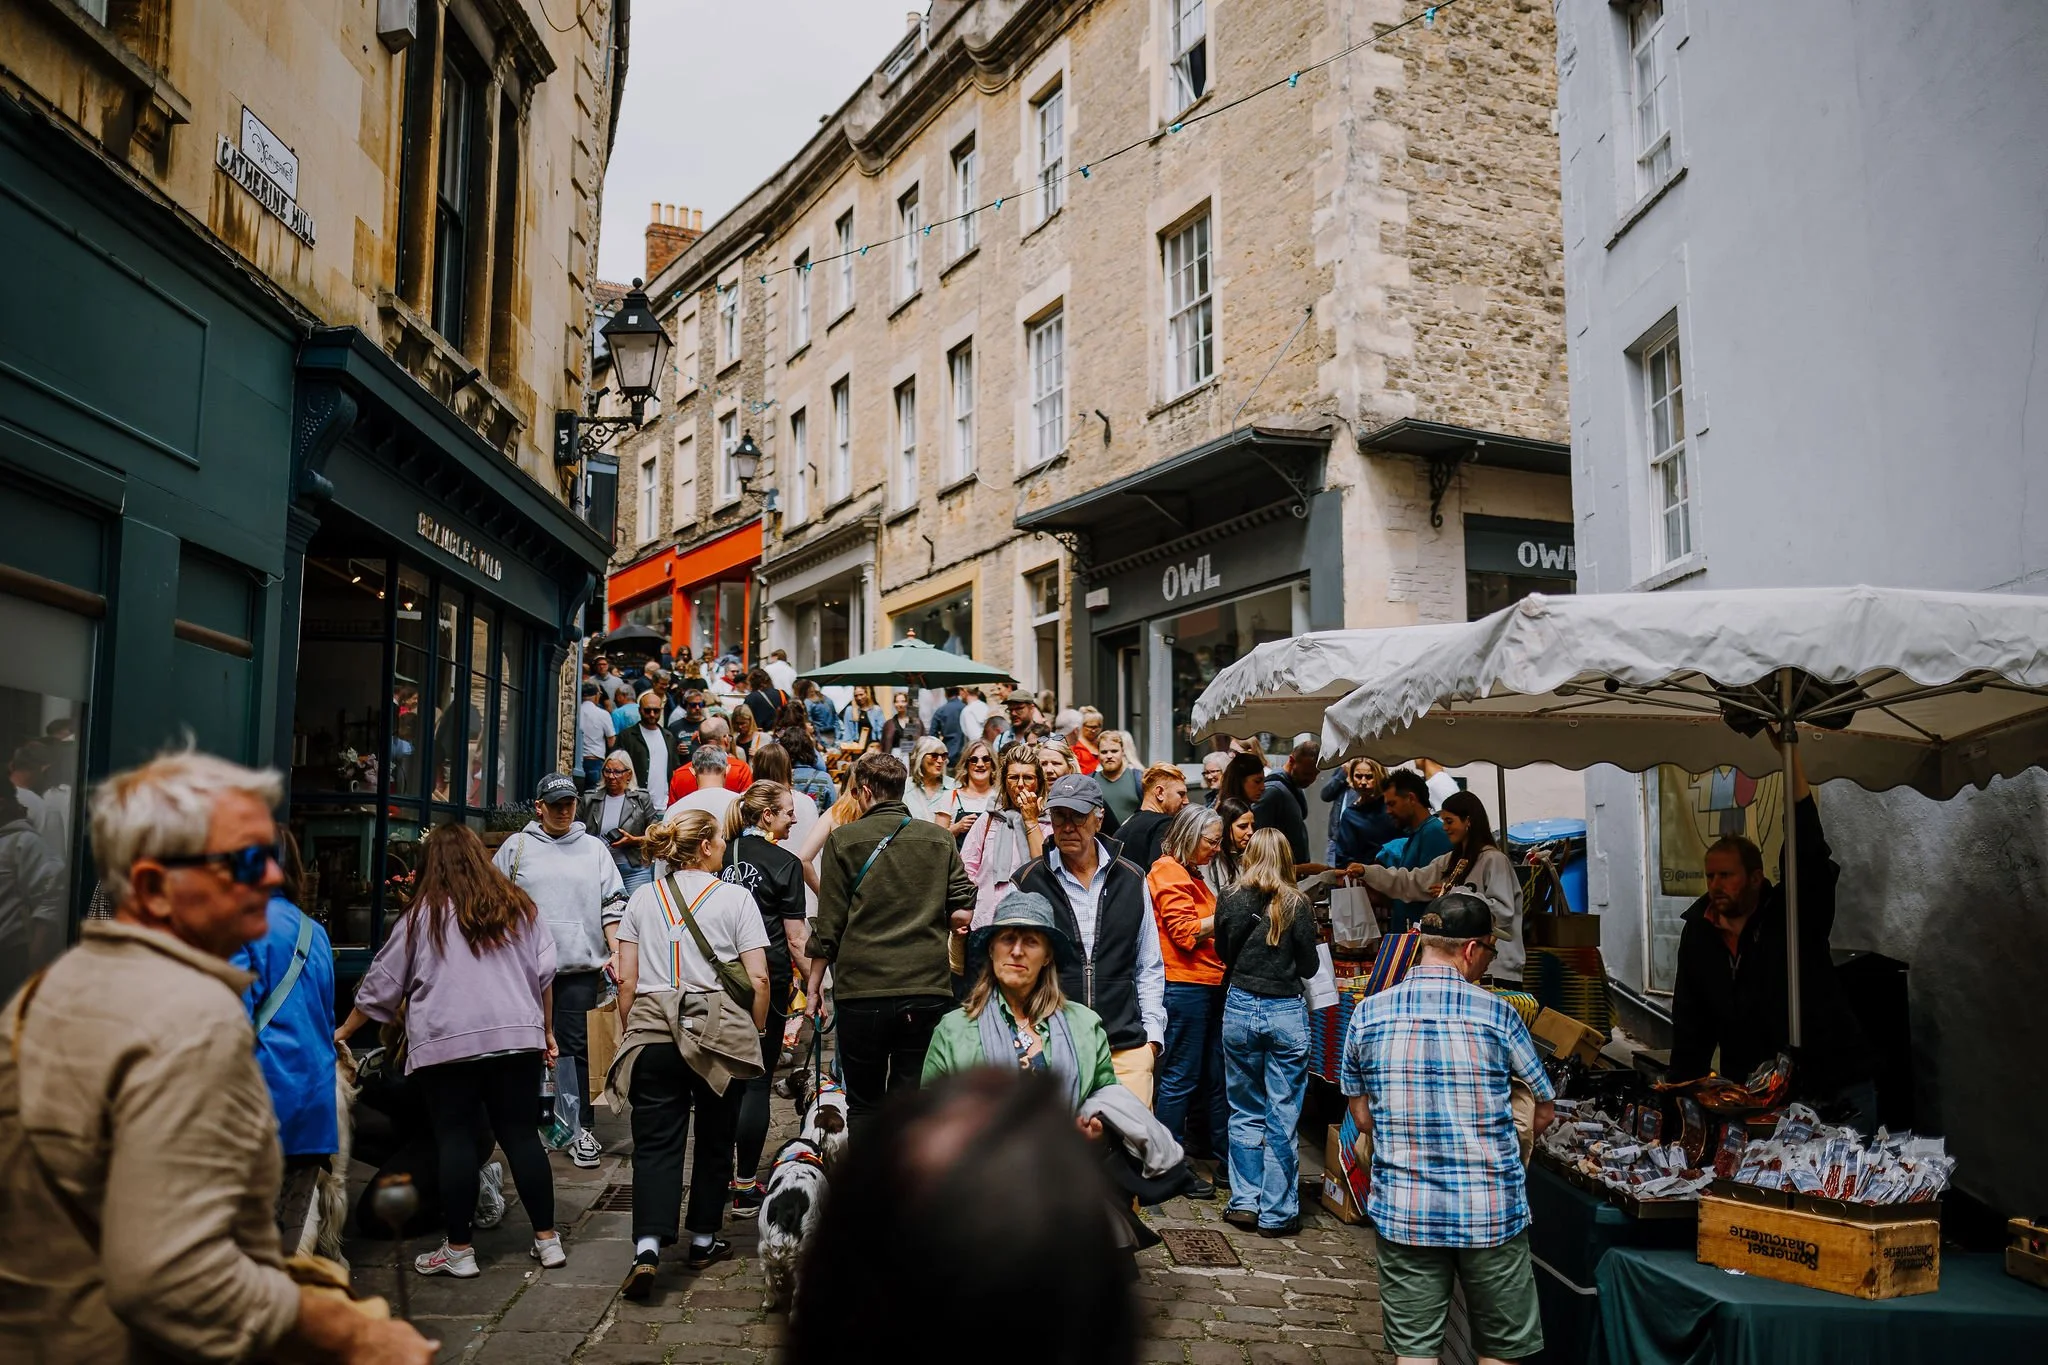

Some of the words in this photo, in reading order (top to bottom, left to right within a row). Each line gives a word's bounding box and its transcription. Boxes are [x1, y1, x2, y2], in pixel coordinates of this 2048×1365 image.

[220, 141, 288, 220] CATHERINE
[291, 204, 316, 246] HILL
[559, 429, 569, 445] 5
[417, 511, 470, 563] BRAMBLE
[479, 549, 502, 581] WILD
[1162, 554, 1221, 602] OWL
[1729, 1225, 1819, 1260] Charcuterie
[1747, 1241, 1818, 1271] Somerset
